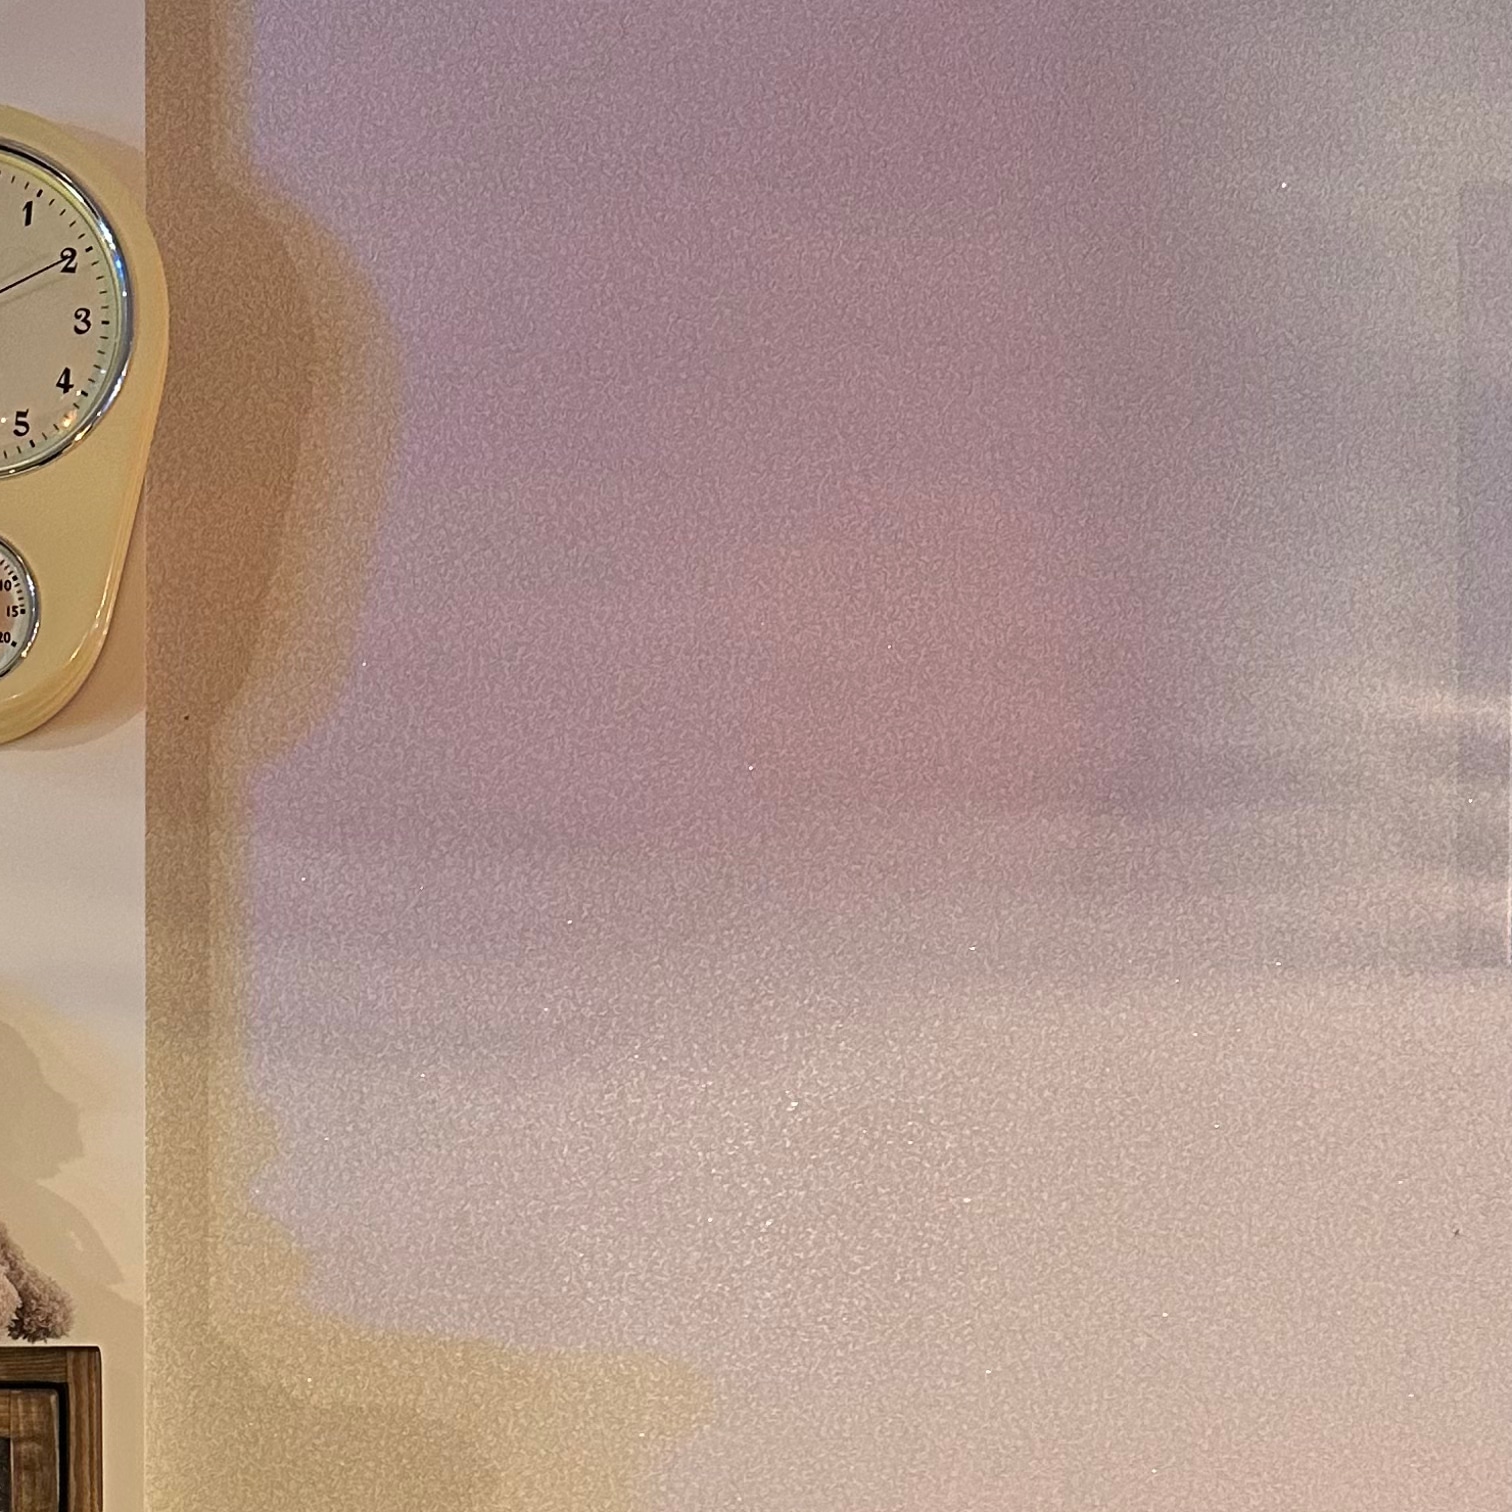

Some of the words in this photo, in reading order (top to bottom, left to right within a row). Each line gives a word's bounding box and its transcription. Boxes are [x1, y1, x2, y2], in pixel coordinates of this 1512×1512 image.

[22, 201, 34, 227] 1
[60, 247, 78, 274] 2
[73, 308, 92, 335] 3
[55, 367, 75, 394] 4
[13, 409, 31, 437] 5
[0, 579, 12, 592] 10
[6, 605, 19, 618] 15
